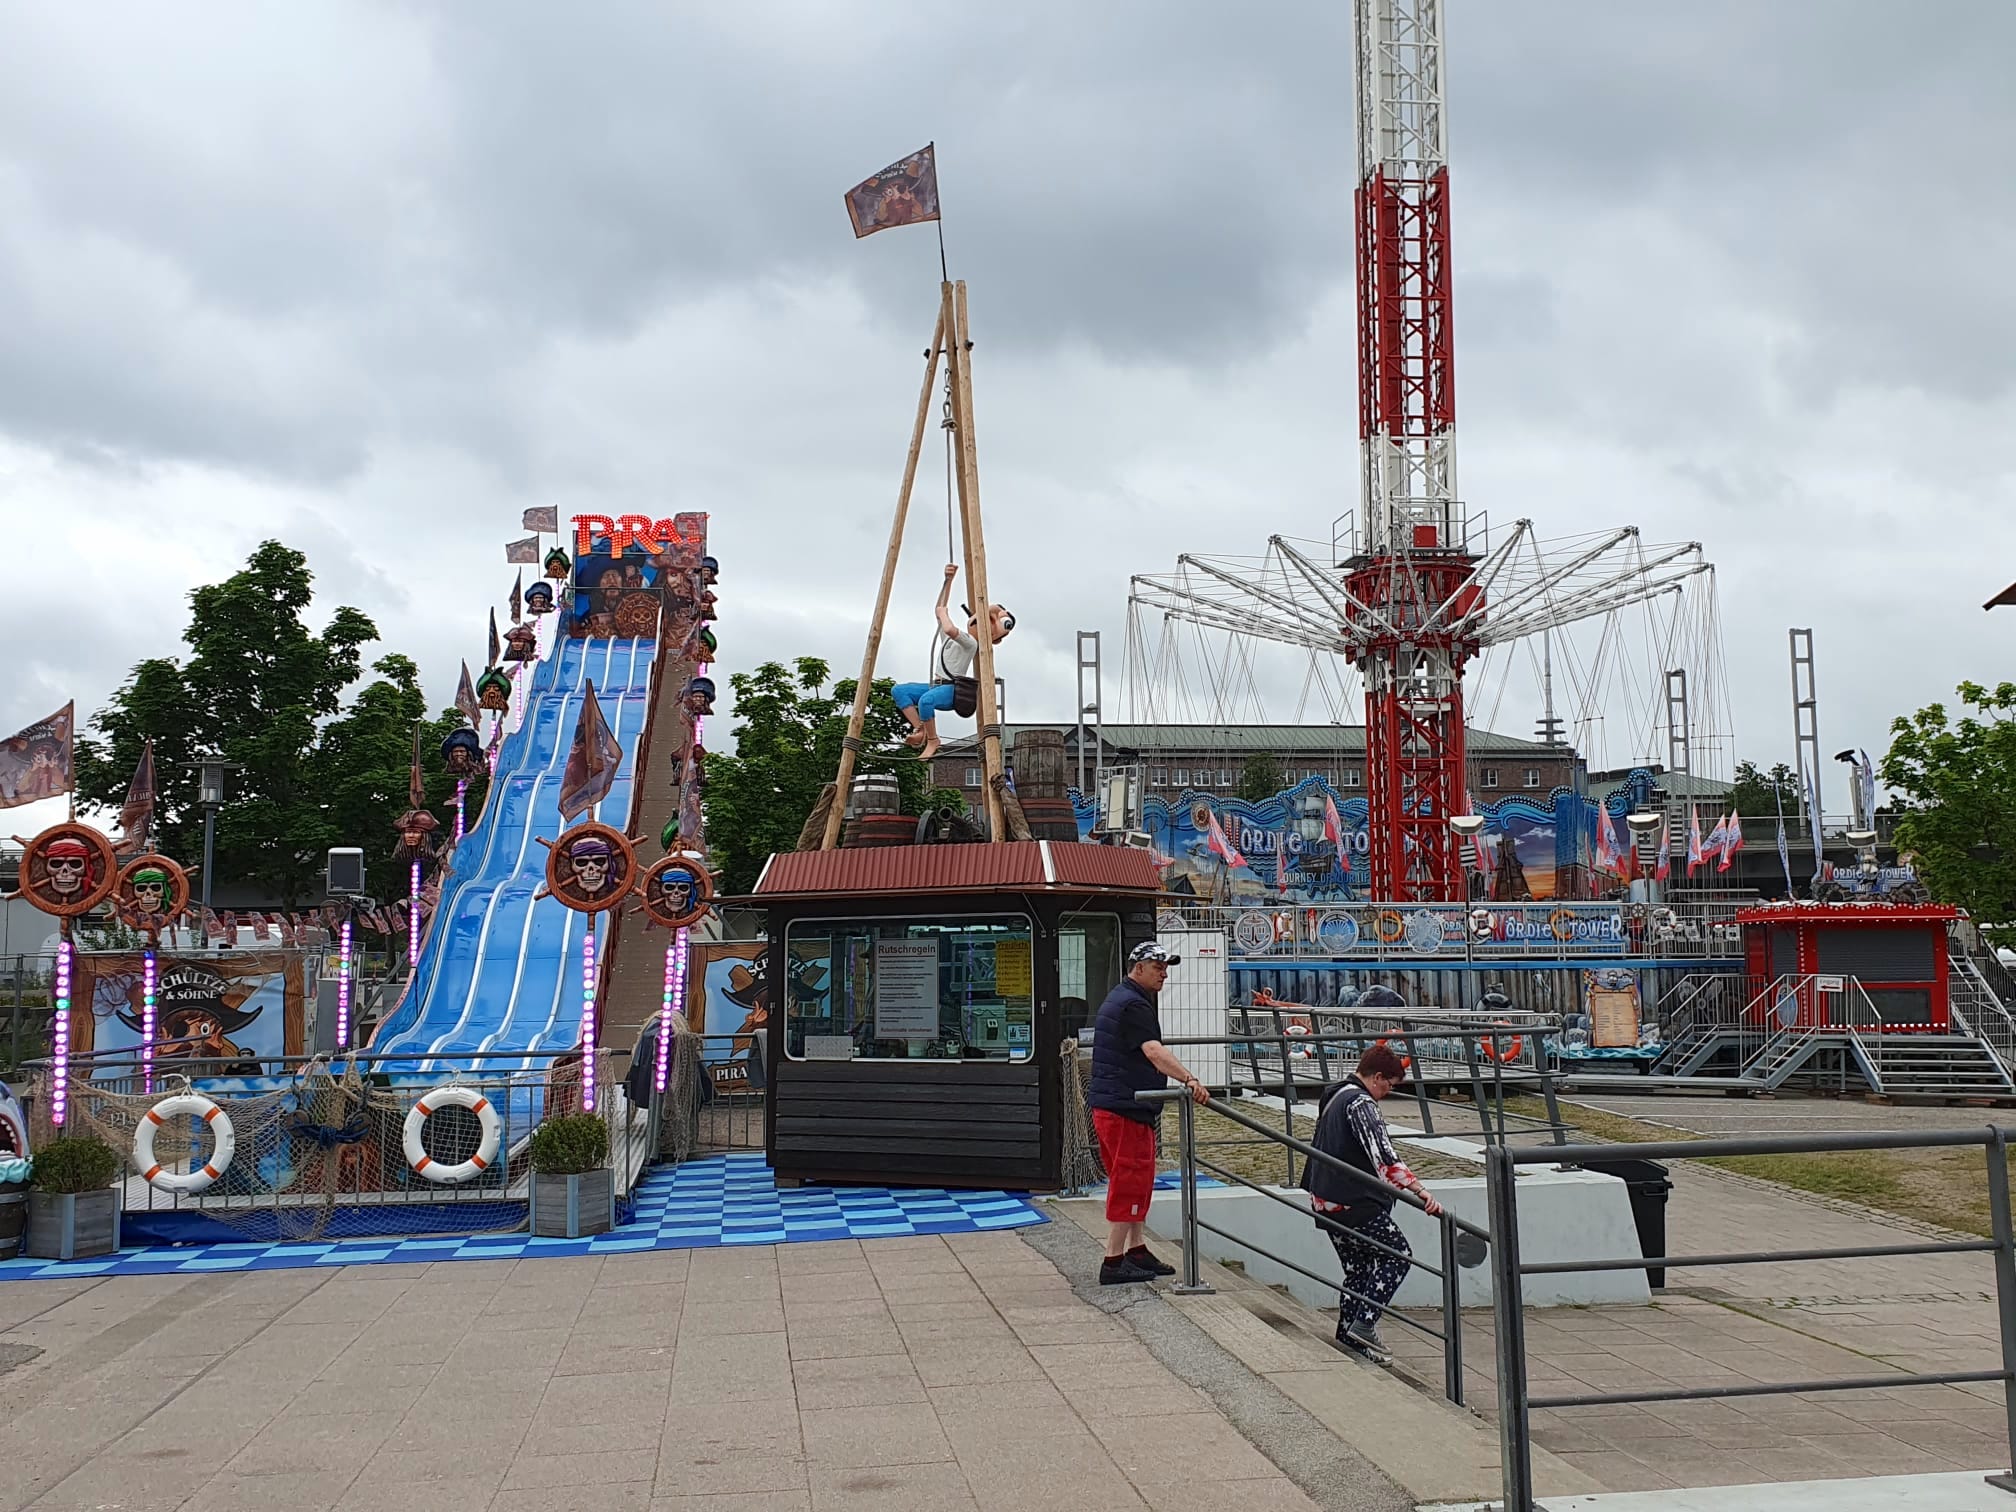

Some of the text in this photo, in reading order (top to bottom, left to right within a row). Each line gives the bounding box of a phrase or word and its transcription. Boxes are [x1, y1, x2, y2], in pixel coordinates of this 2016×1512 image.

[1823, 862, 1914, 881] NORDIC TOWER
[1569, 914, 1621, 941] TOWER
[878, 945, 936, 955] Rutschregeln
[166, 988, 217, 1000] & SÖHNE
[716, 1066, 748, 1081] PIRA
